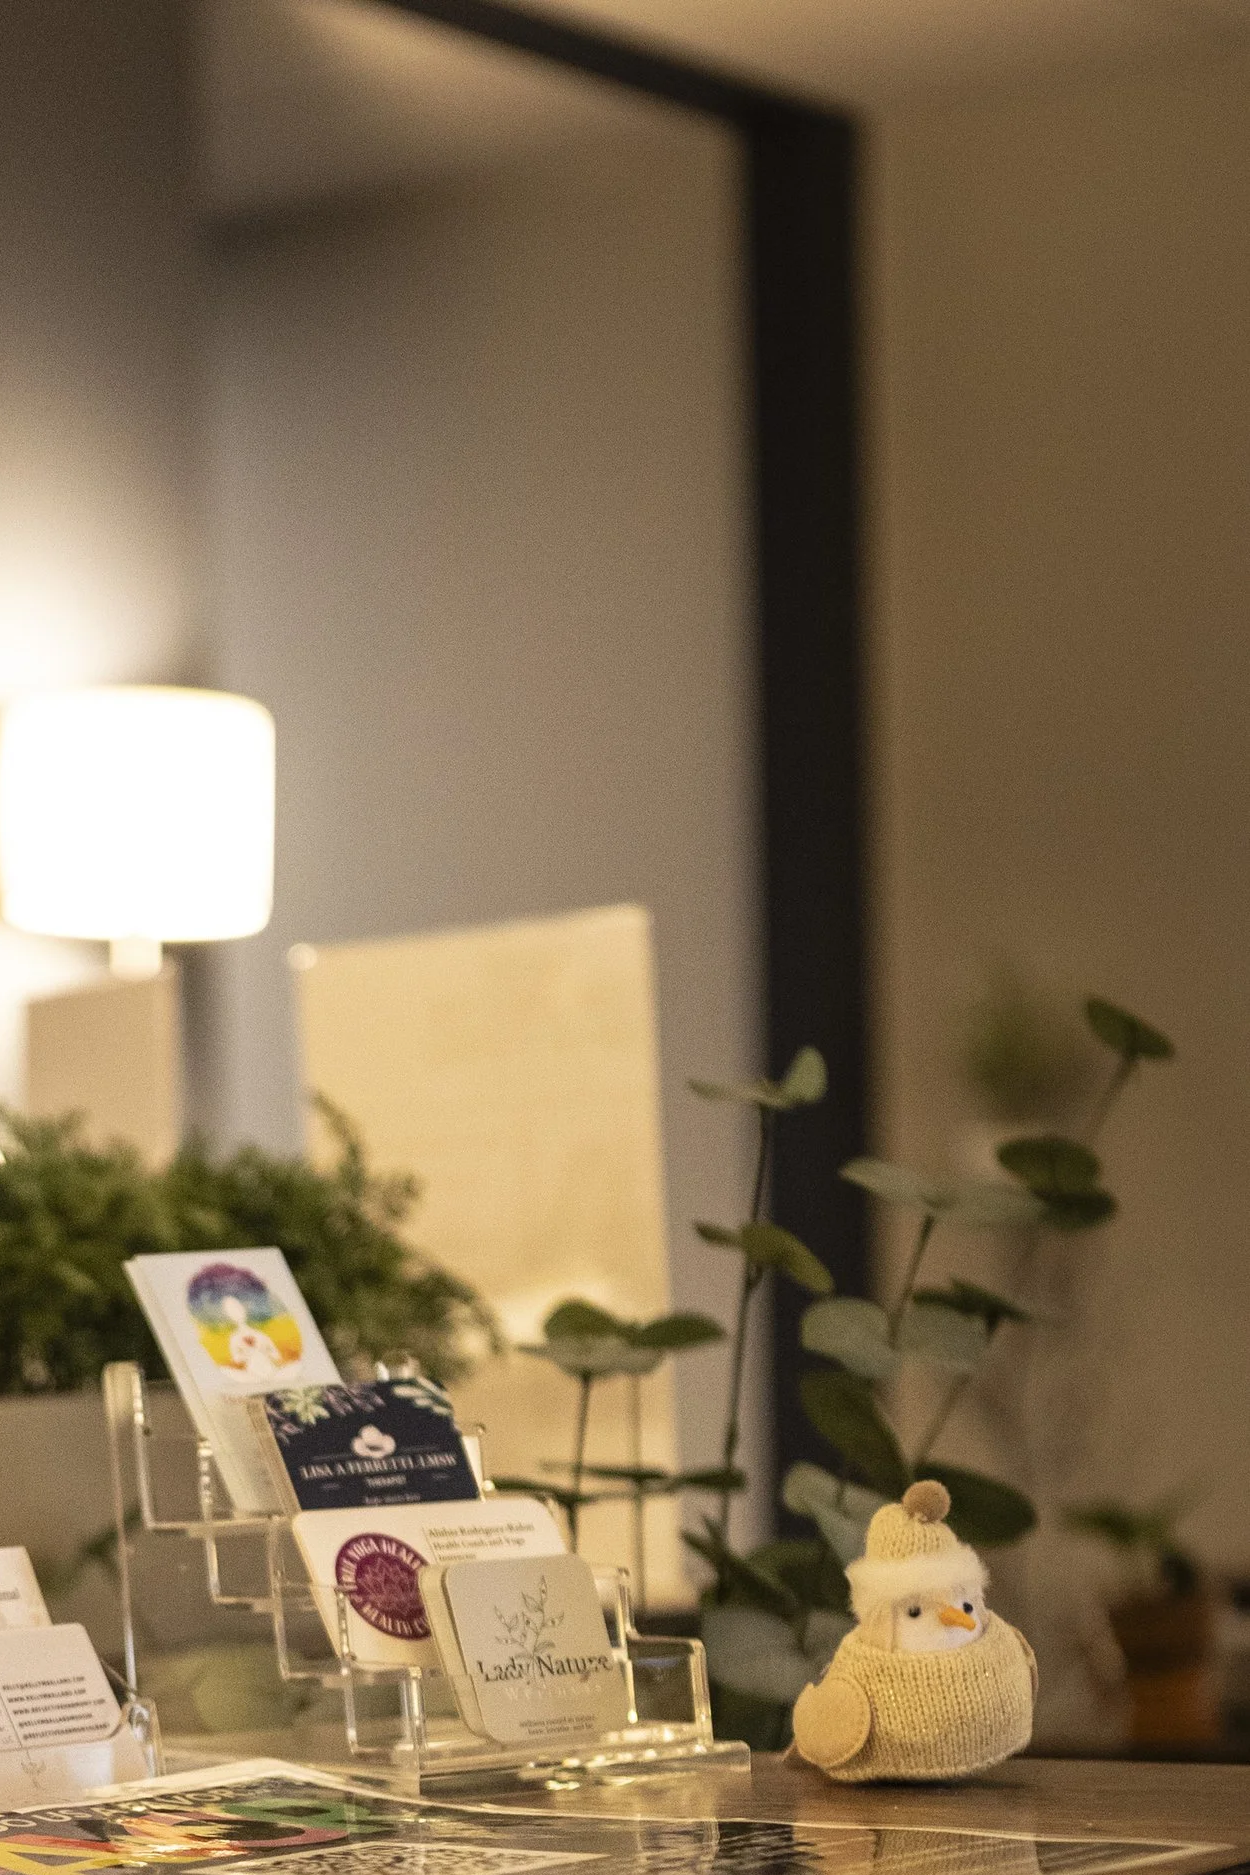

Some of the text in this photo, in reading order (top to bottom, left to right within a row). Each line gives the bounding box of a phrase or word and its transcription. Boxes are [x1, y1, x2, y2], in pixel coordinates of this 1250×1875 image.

[347, 1537, 380, 1561] YOGA
[477, 1654, 614, 1686] Lady Nature
[32, 1807, 91, 1826] US
